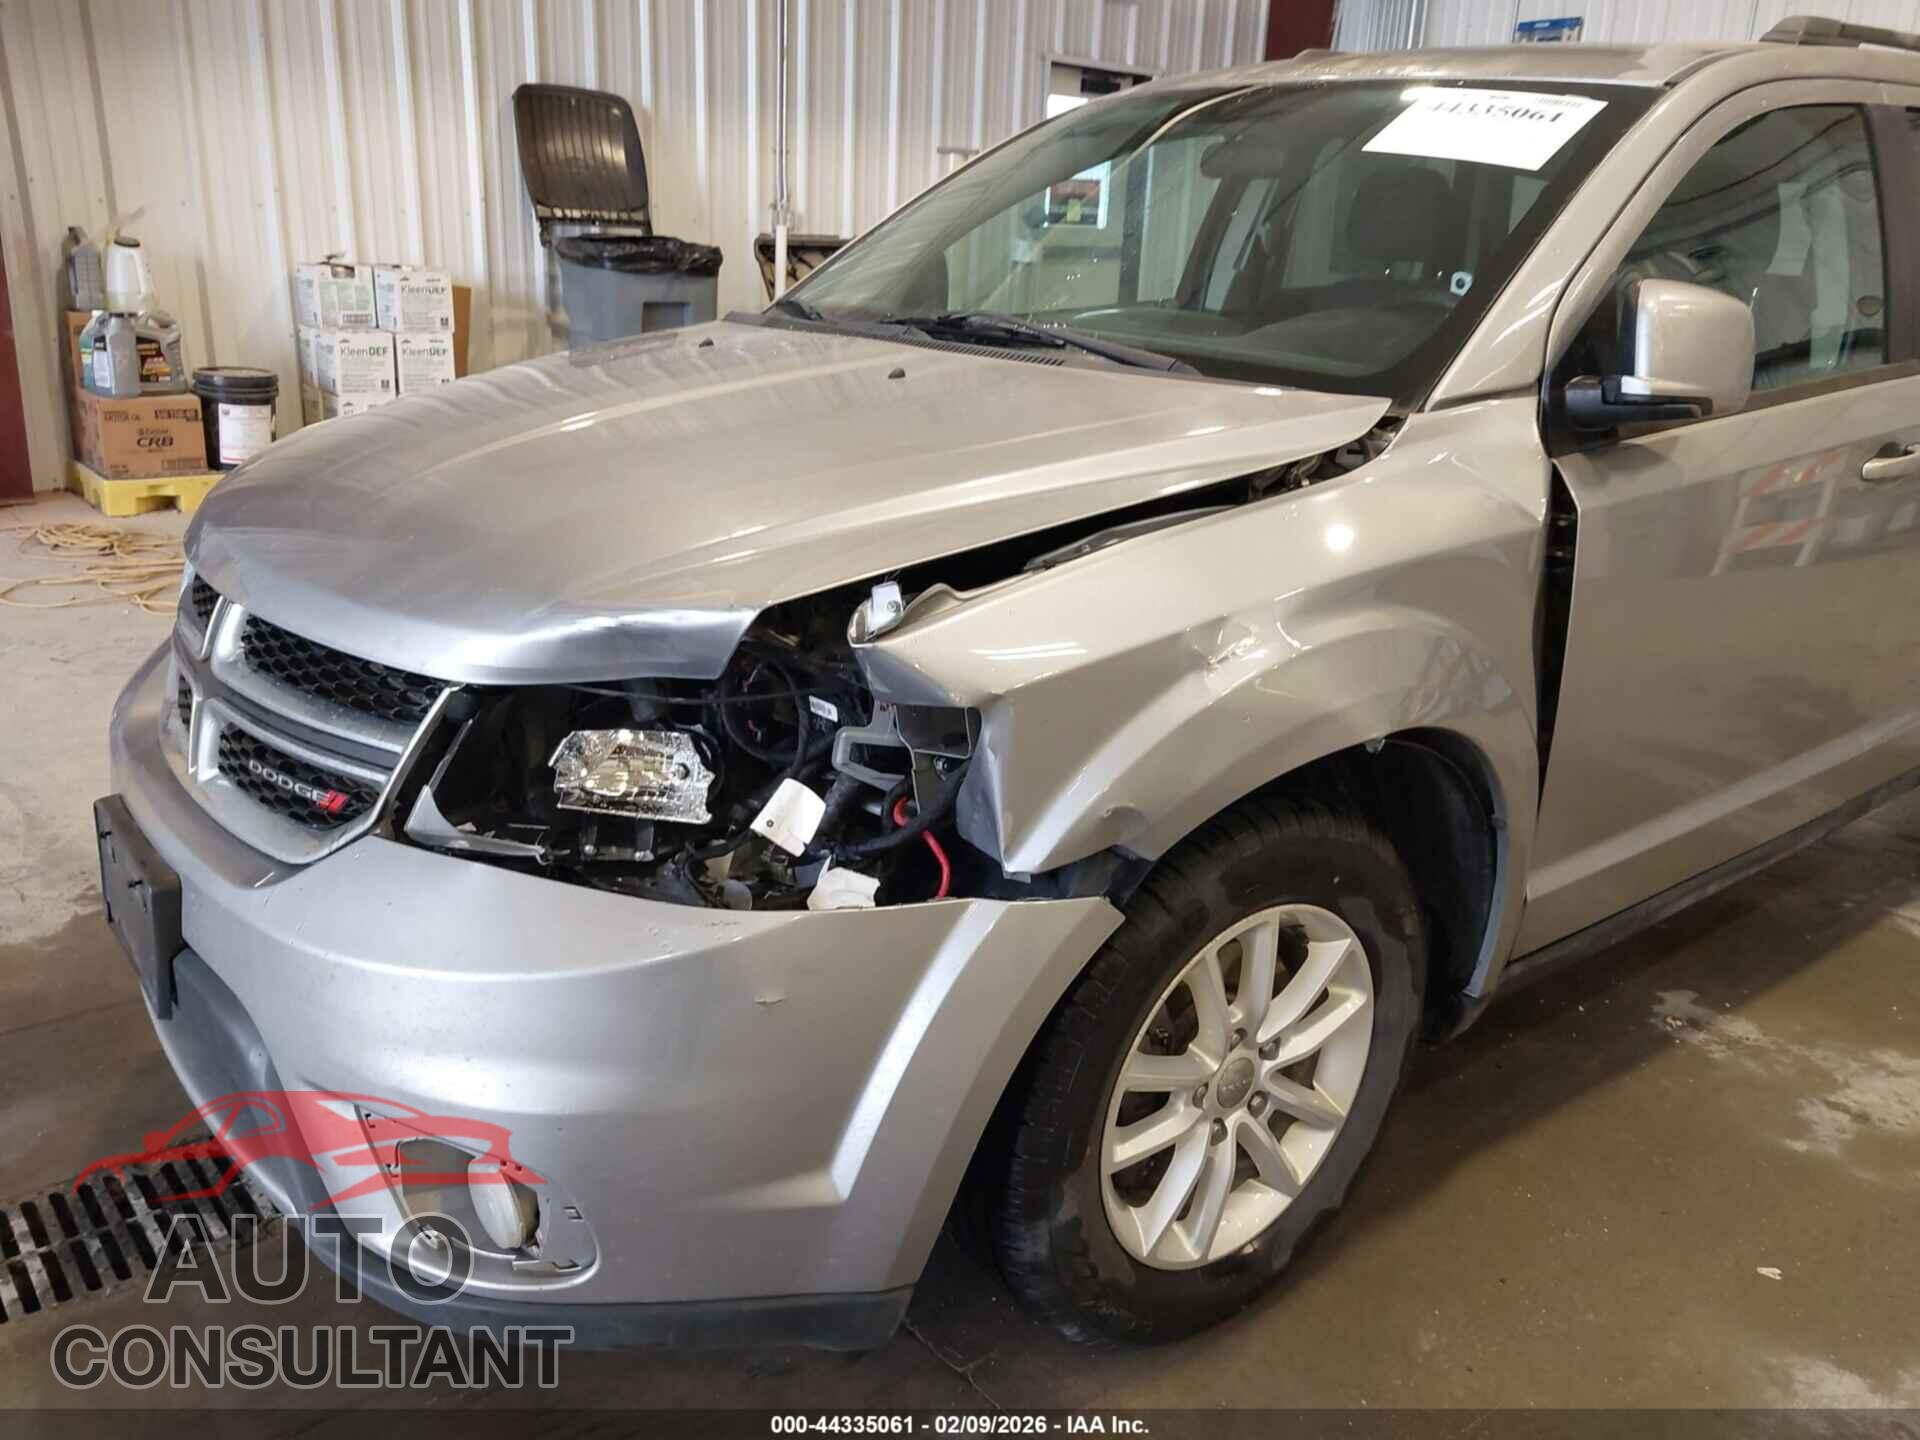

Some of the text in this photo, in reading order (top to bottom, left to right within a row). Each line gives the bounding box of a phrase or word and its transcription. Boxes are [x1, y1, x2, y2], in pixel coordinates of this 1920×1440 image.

[340, 346, 387, 357] KleenDEF
[402, 346, 448, 357] KleenDEF
[136, 436, 174, 448] CRB
[248, 759, 331, 808] DODGE
